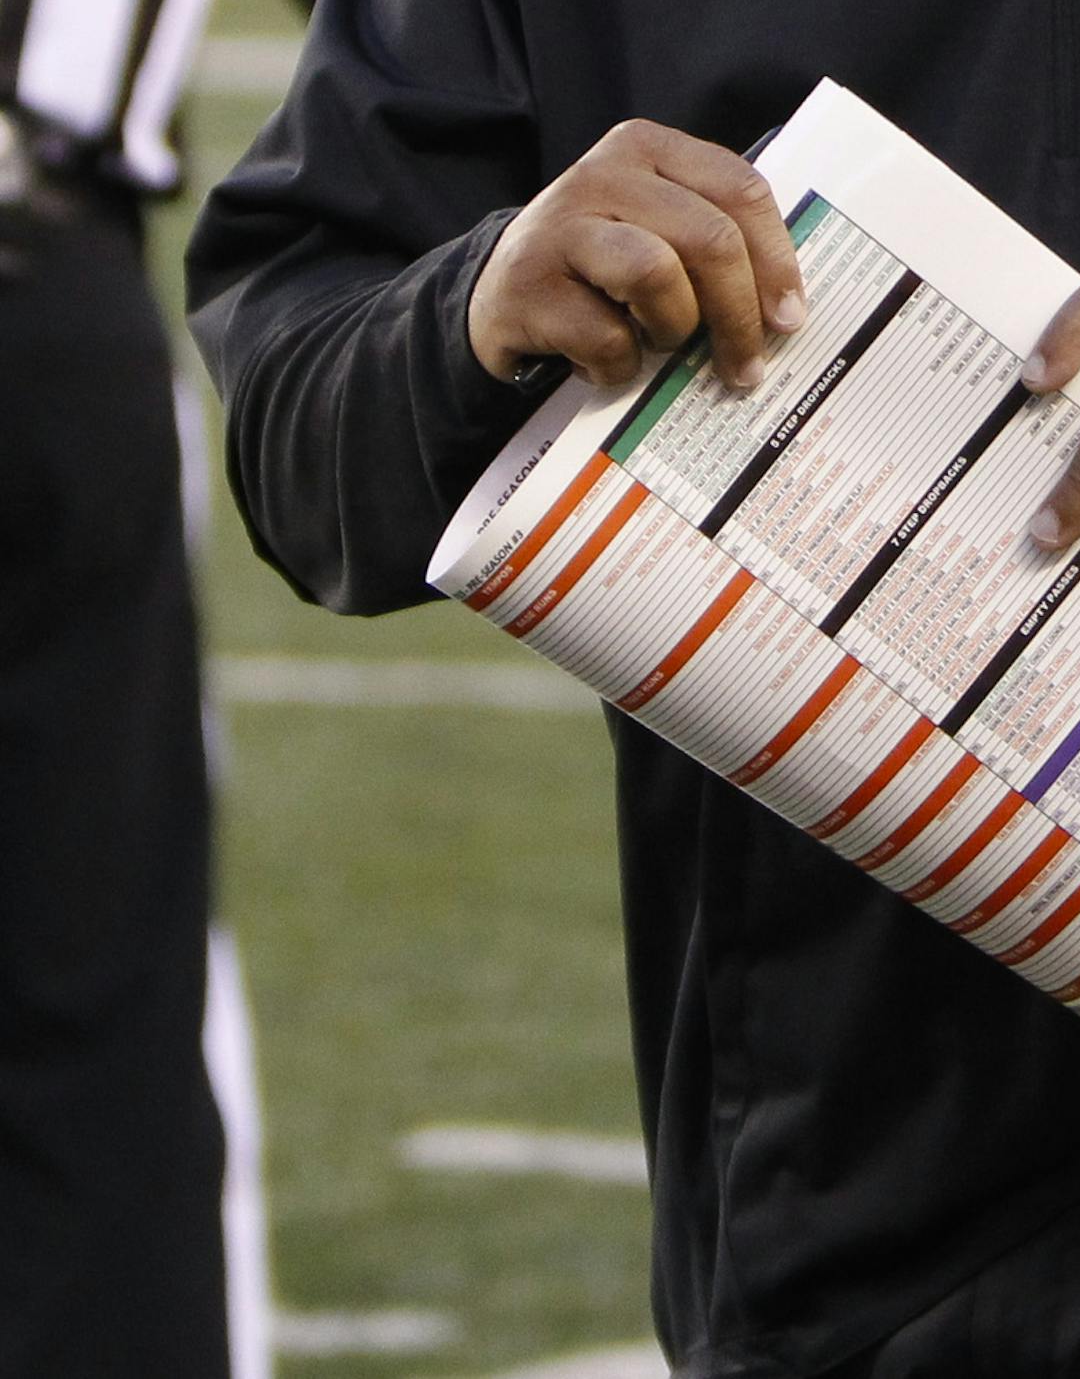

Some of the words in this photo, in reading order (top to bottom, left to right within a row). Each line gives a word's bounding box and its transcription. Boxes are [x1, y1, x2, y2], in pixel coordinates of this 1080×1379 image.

[768, 437, 780, 448] 5
[774, 413, 800, 441] STEP
[794, 356, 847, 417] DROPBACKS
[889, 536, 900, 548] 7
[895, 512, 921, 541] STEP
[915, 454, 968, 516] DROPBACKS
[466, 541, 514, 592] PRE-SEASON
[1018, 600, 1050, 636] EMPTY
[1045, 563, 1080, 604] PASSES
